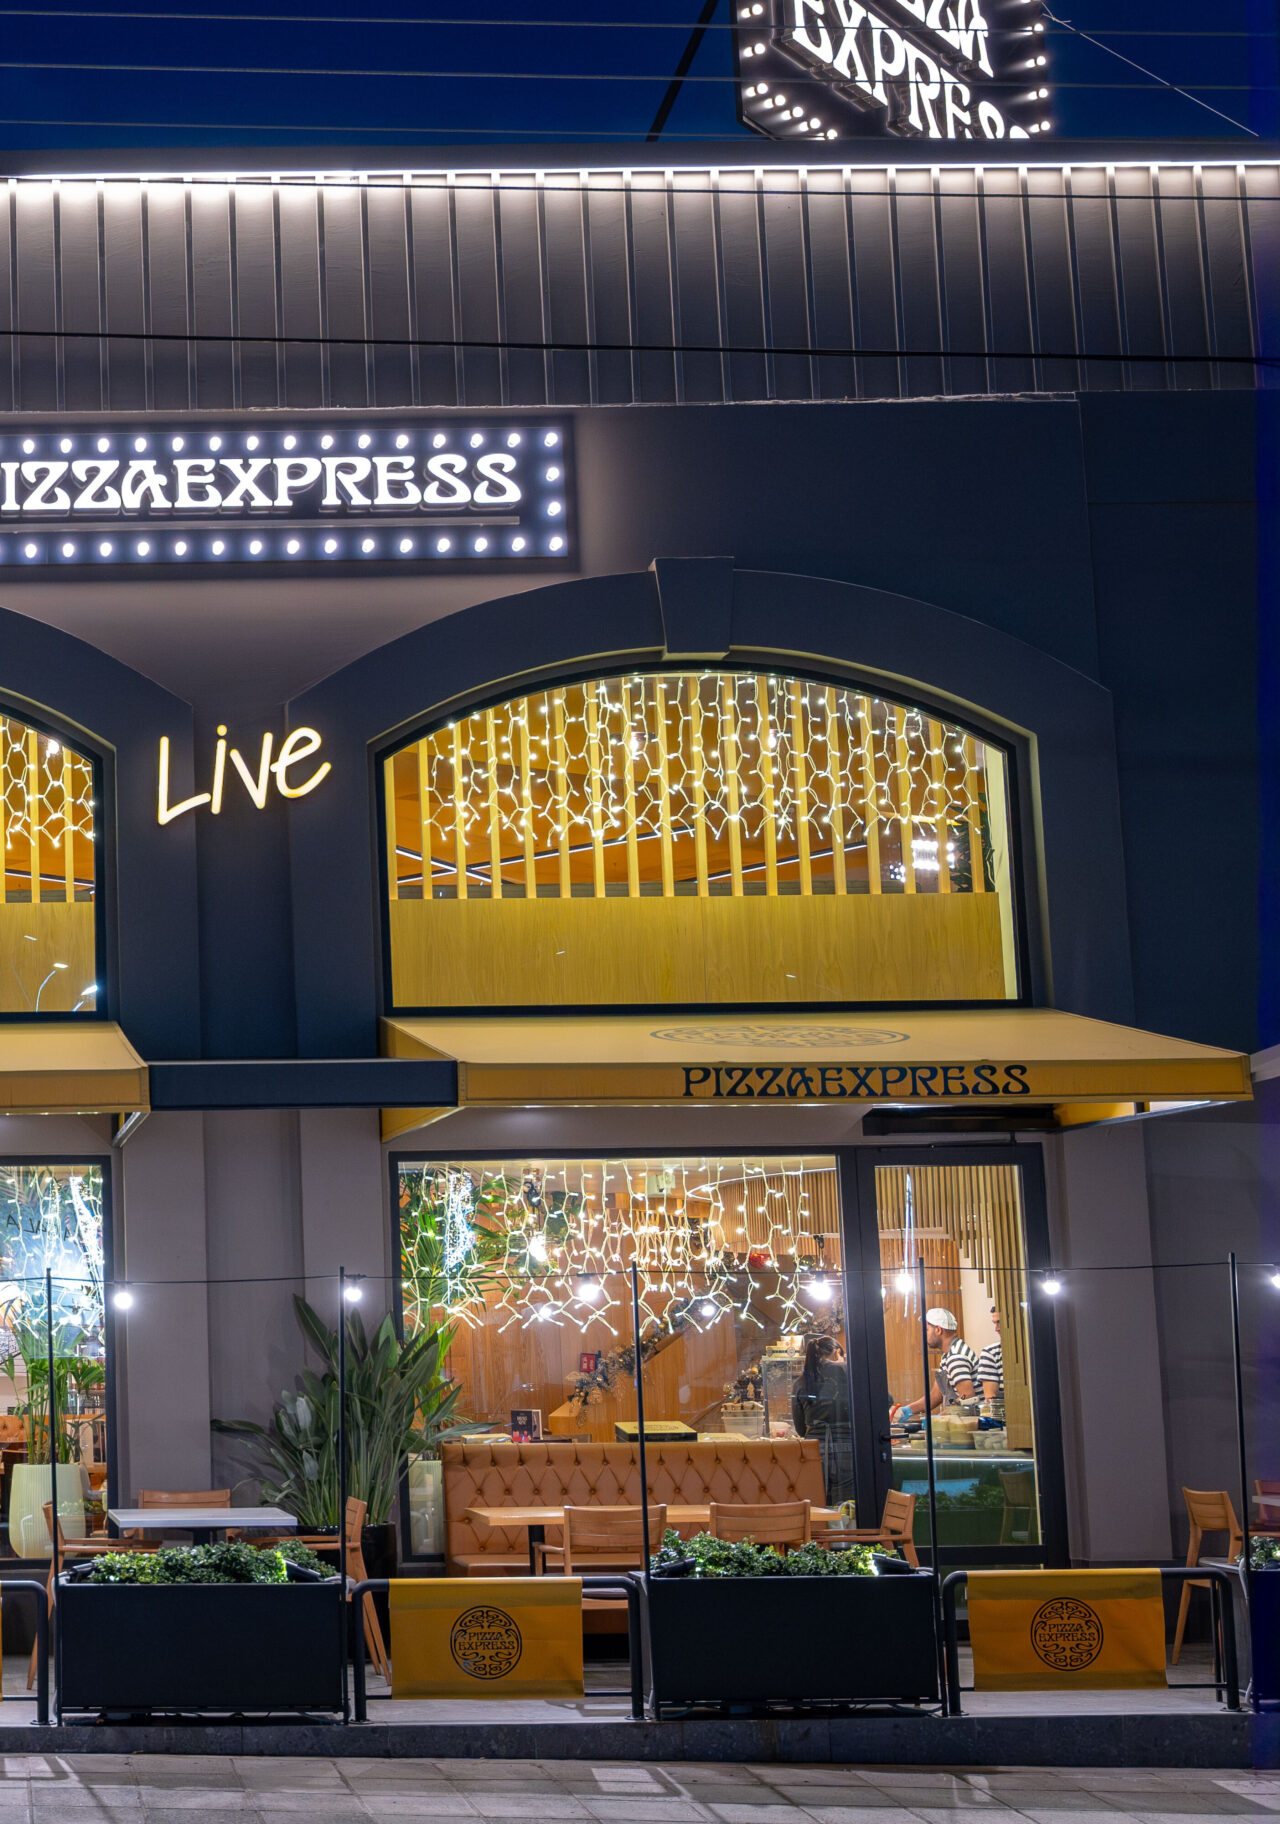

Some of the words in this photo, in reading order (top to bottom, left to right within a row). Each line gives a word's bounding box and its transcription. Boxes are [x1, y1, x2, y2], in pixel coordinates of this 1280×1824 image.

[158, 724, 332, 825] Live
[1048, 1623, 1084, 1633] PIZZA
[468, 1631, 504, 1641] PIZZA
[1038, 1632, 1096, 1642] EXPRESS
[458, 1641, 516, 1651] EXPRESS
